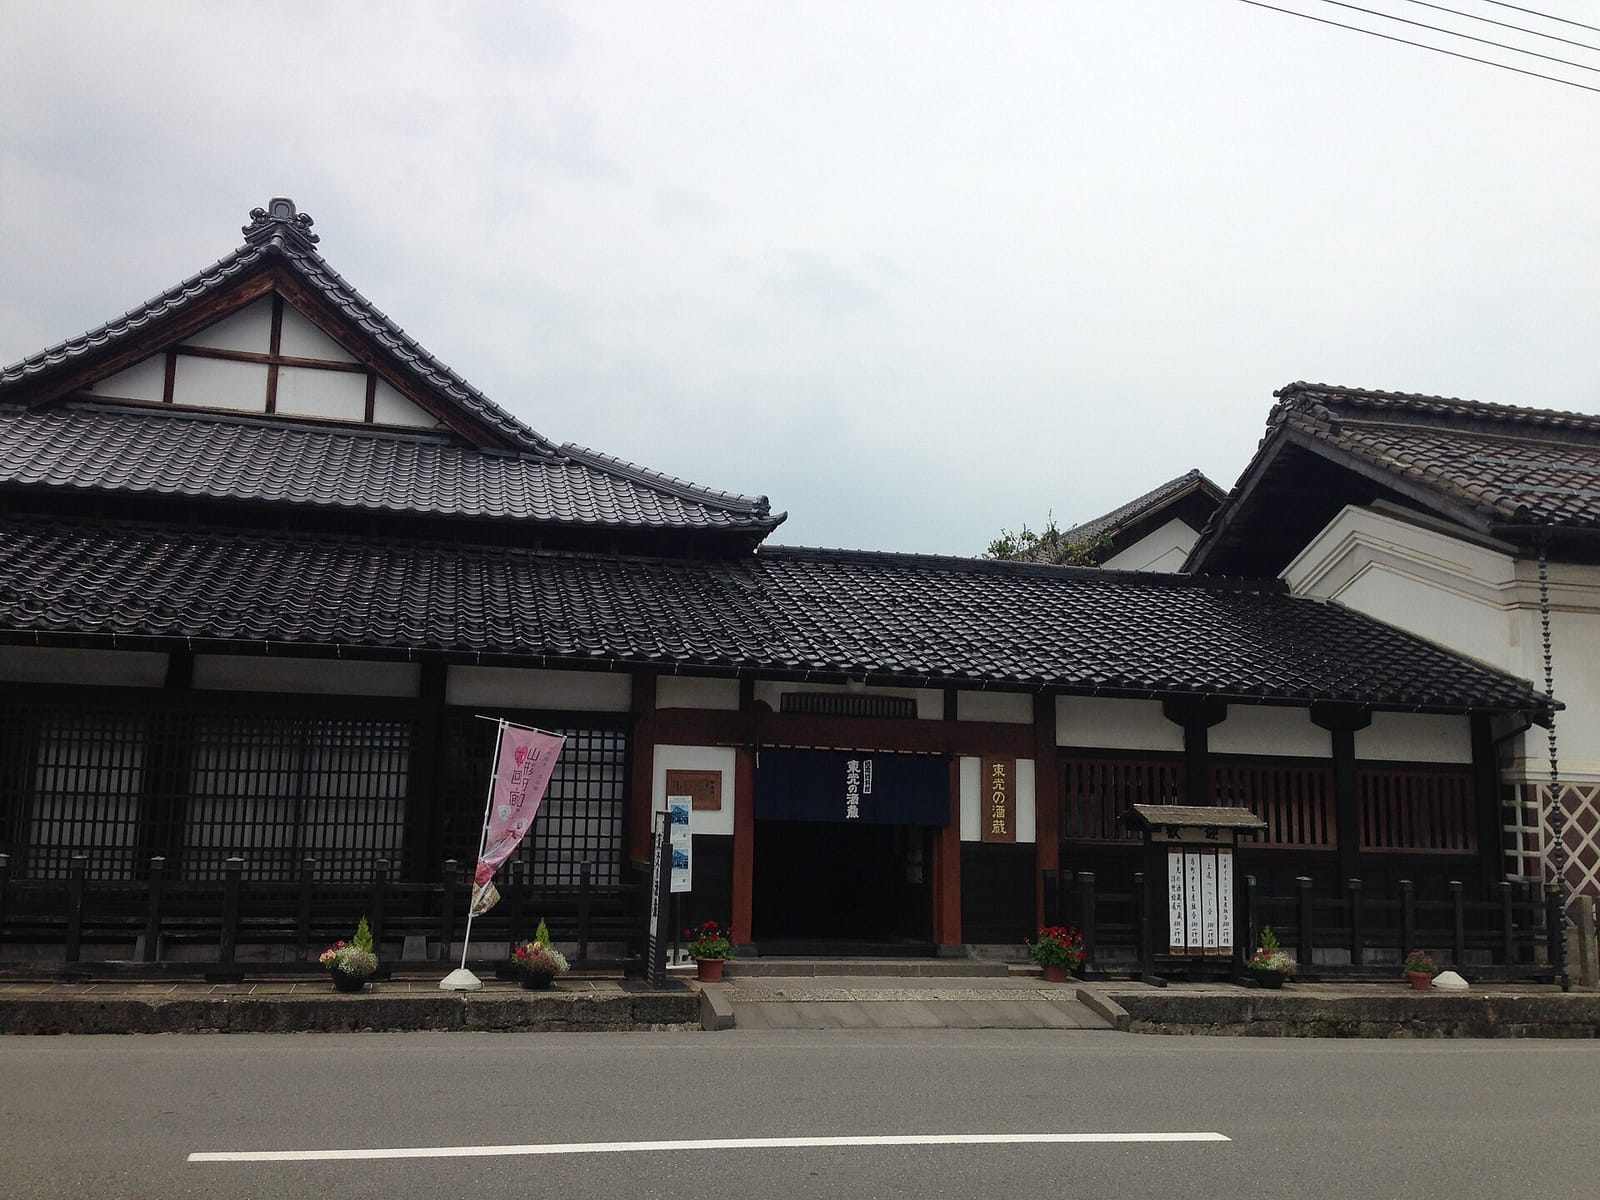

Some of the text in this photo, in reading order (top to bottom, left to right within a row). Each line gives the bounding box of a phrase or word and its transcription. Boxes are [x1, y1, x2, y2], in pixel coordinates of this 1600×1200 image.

[846, 760, 861, 819] 東光の酒蔵
[991, 763, 1007, 834] 東光の酒蔵
